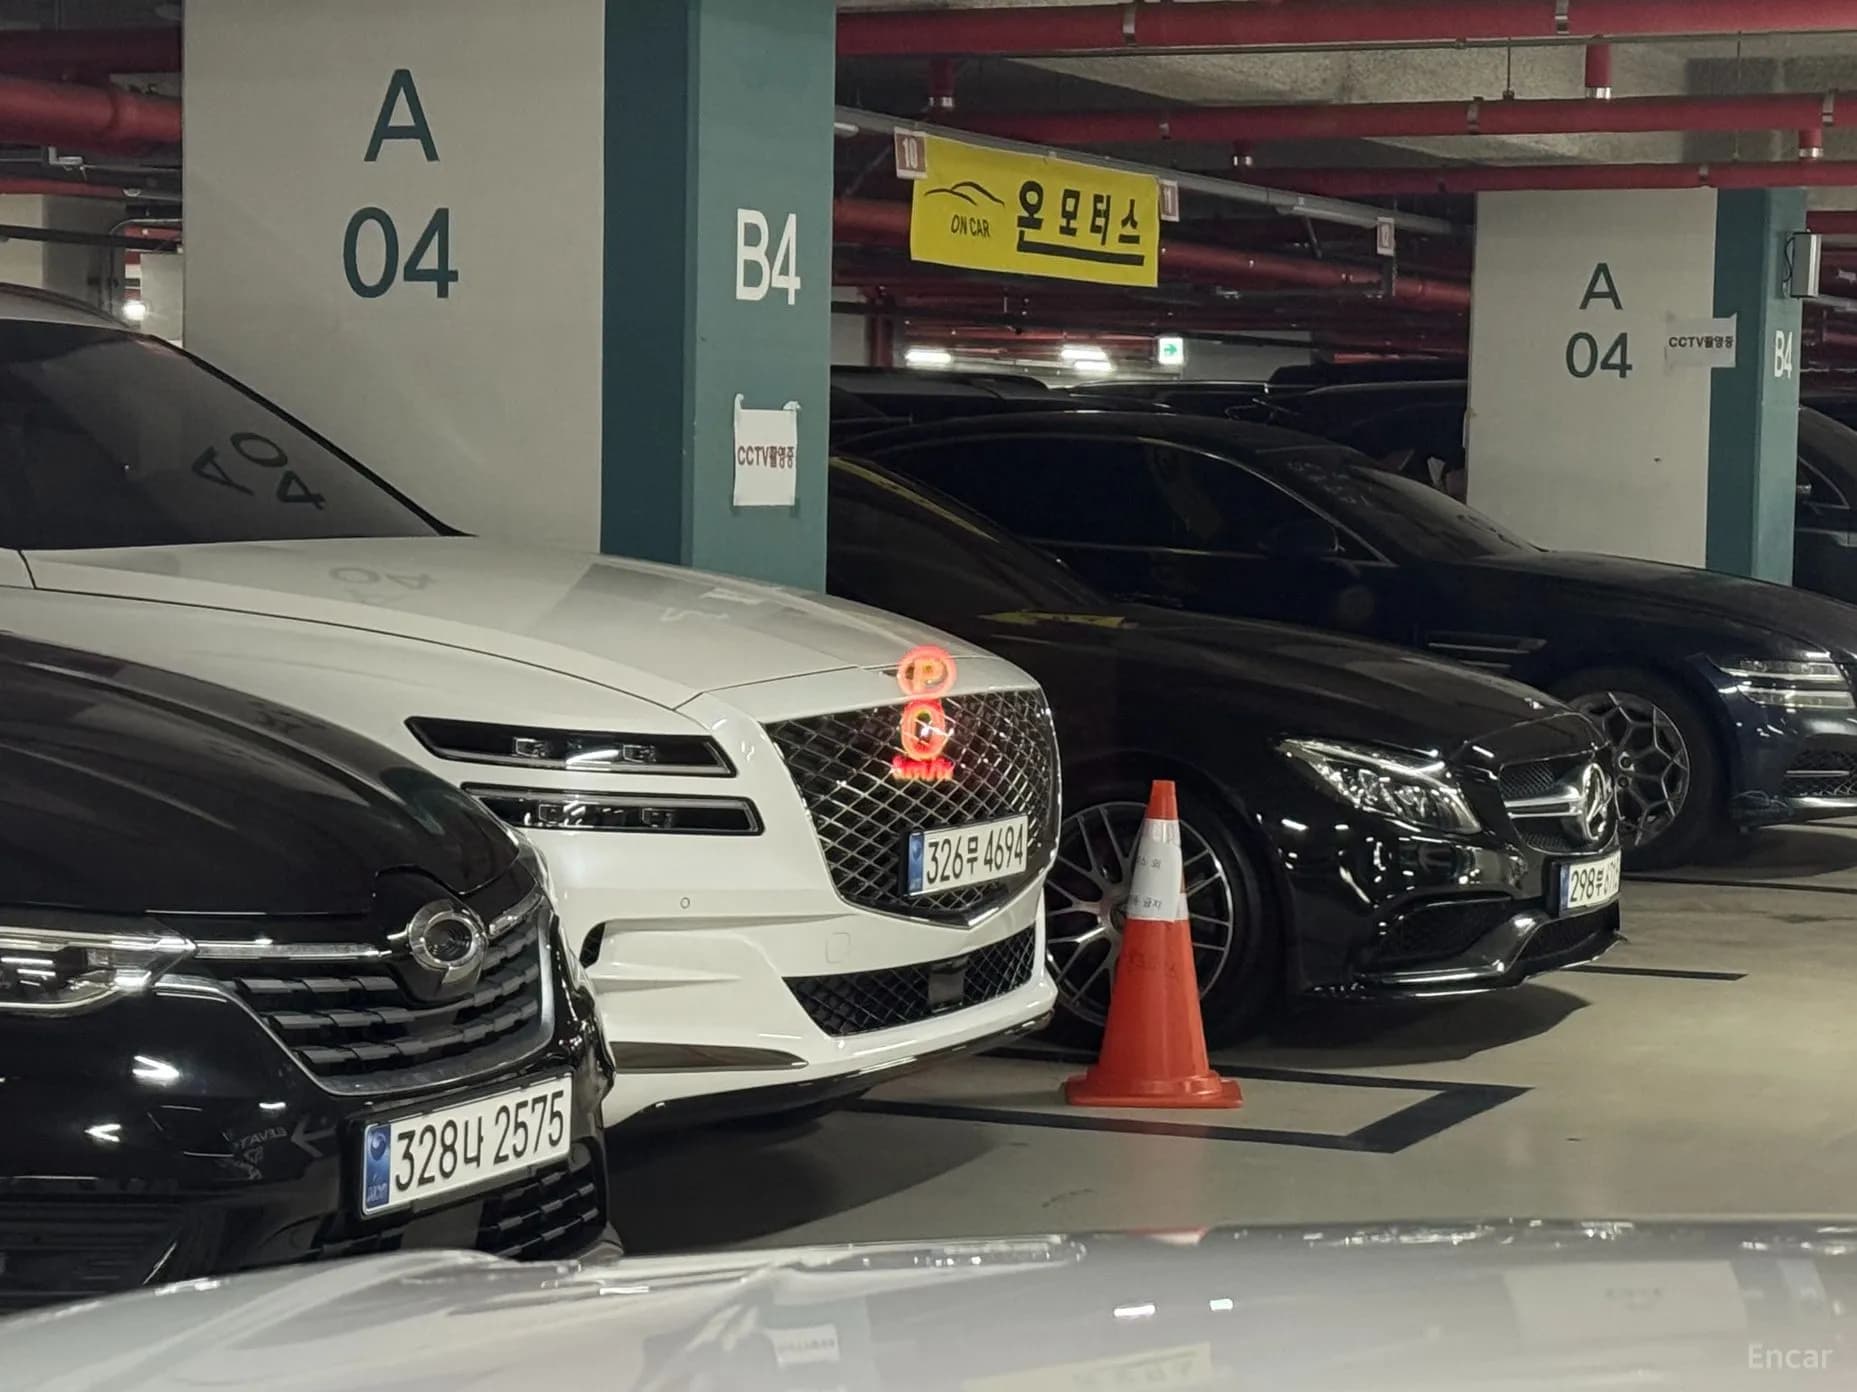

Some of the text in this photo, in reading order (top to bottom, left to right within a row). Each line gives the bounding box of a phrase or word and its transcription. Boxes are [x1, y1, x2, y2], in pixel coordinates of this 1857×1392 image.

[364, 68, 440, 162] A
[901, 137, 919, 170] 10
[950, 214, 991, 238] ON CAR
[343, 206, 459, 299] 04
[736, 207, 801, 306] B4
[1579, 262, 1624, 310] A
[1565, 332, 1633, 379] 04
[1774, 330, 1793, 379] B4
[736, 445, 795, 470] CCTV촬영중
[926, 823, 1025, 886] 326무 4694
[395, 1090, 565, 1192] 328나 2575
